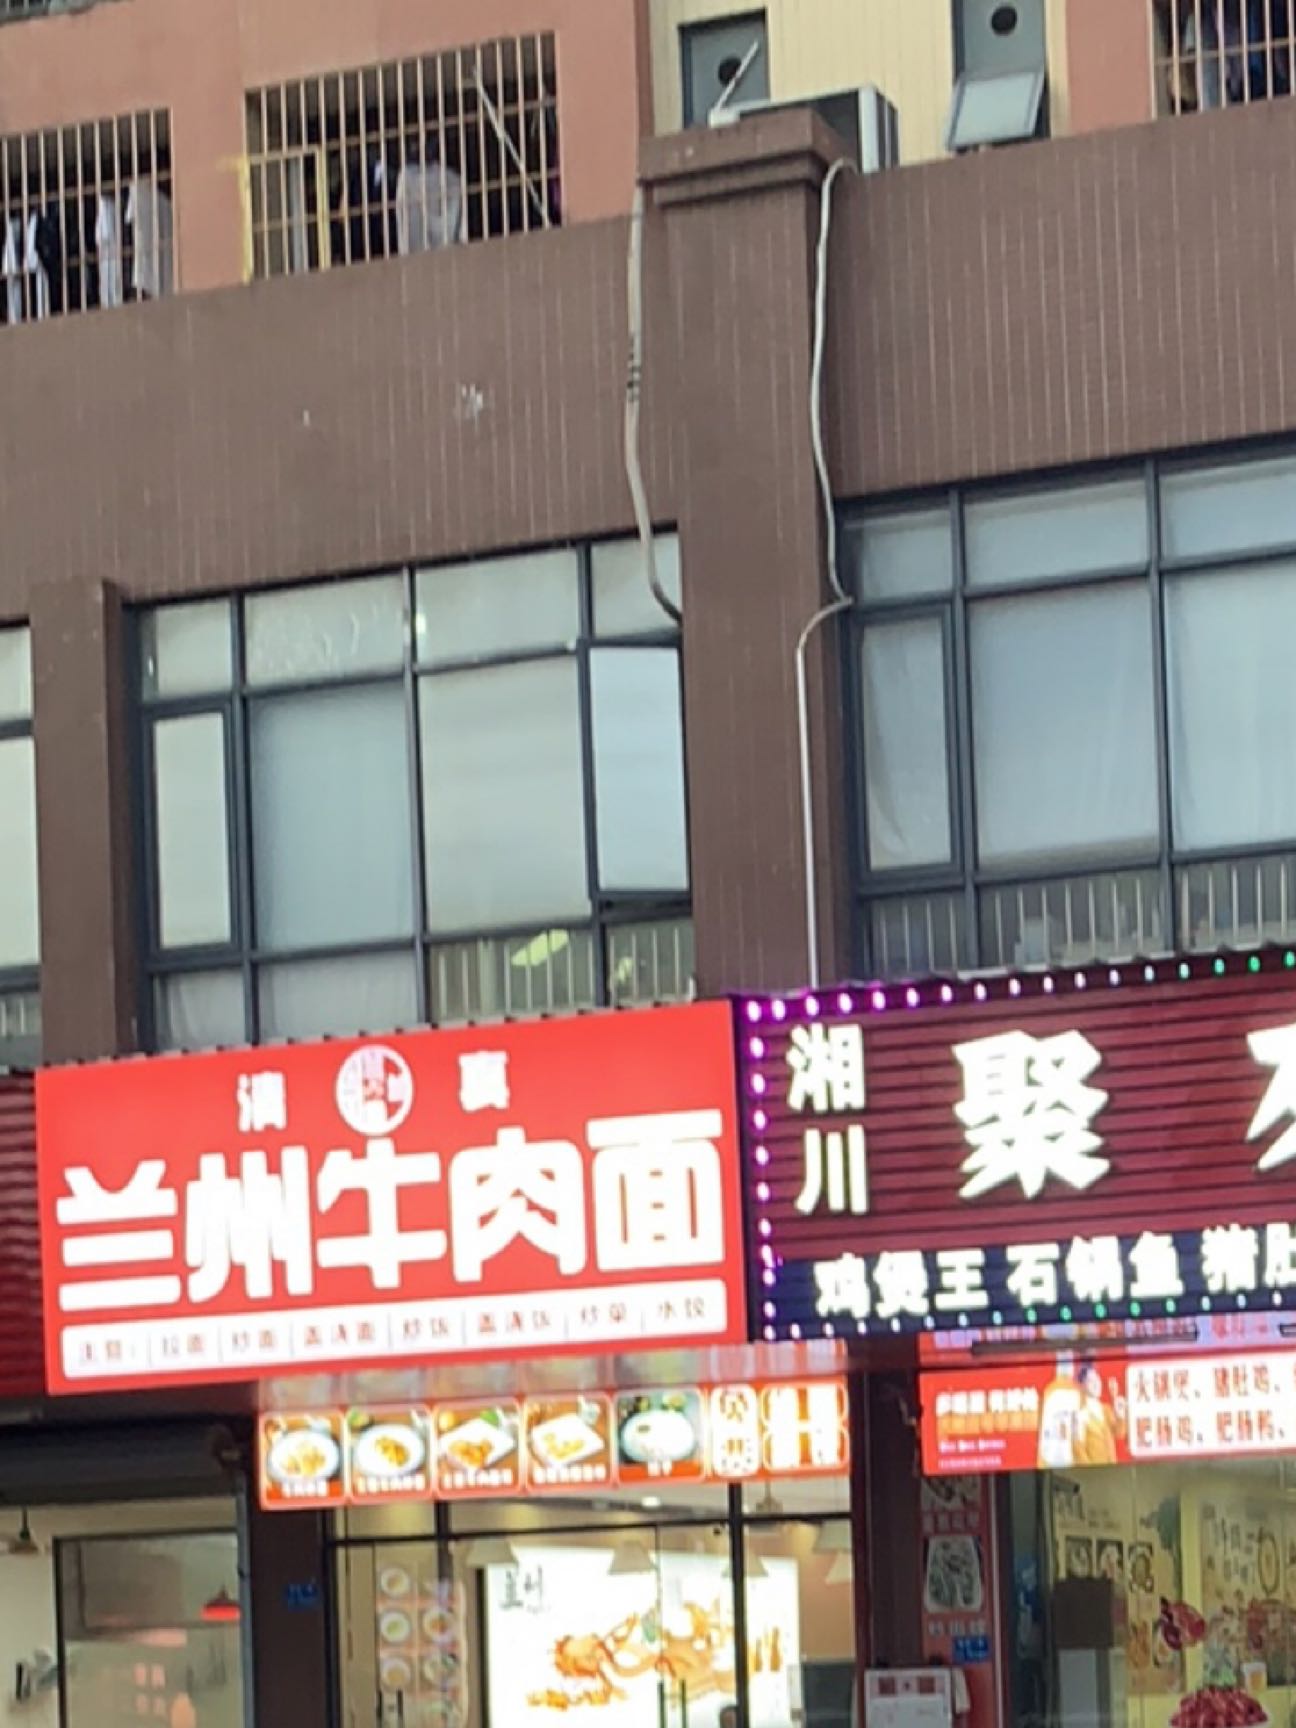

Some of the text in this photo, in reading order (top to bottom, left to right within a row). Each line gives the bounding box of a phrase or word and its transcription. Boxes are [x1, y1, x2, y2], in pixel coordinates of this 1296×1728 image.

[57, 1109, 725, 1311] 兰州牛肉面
[787, 1023, 867, 1213] 湘川
